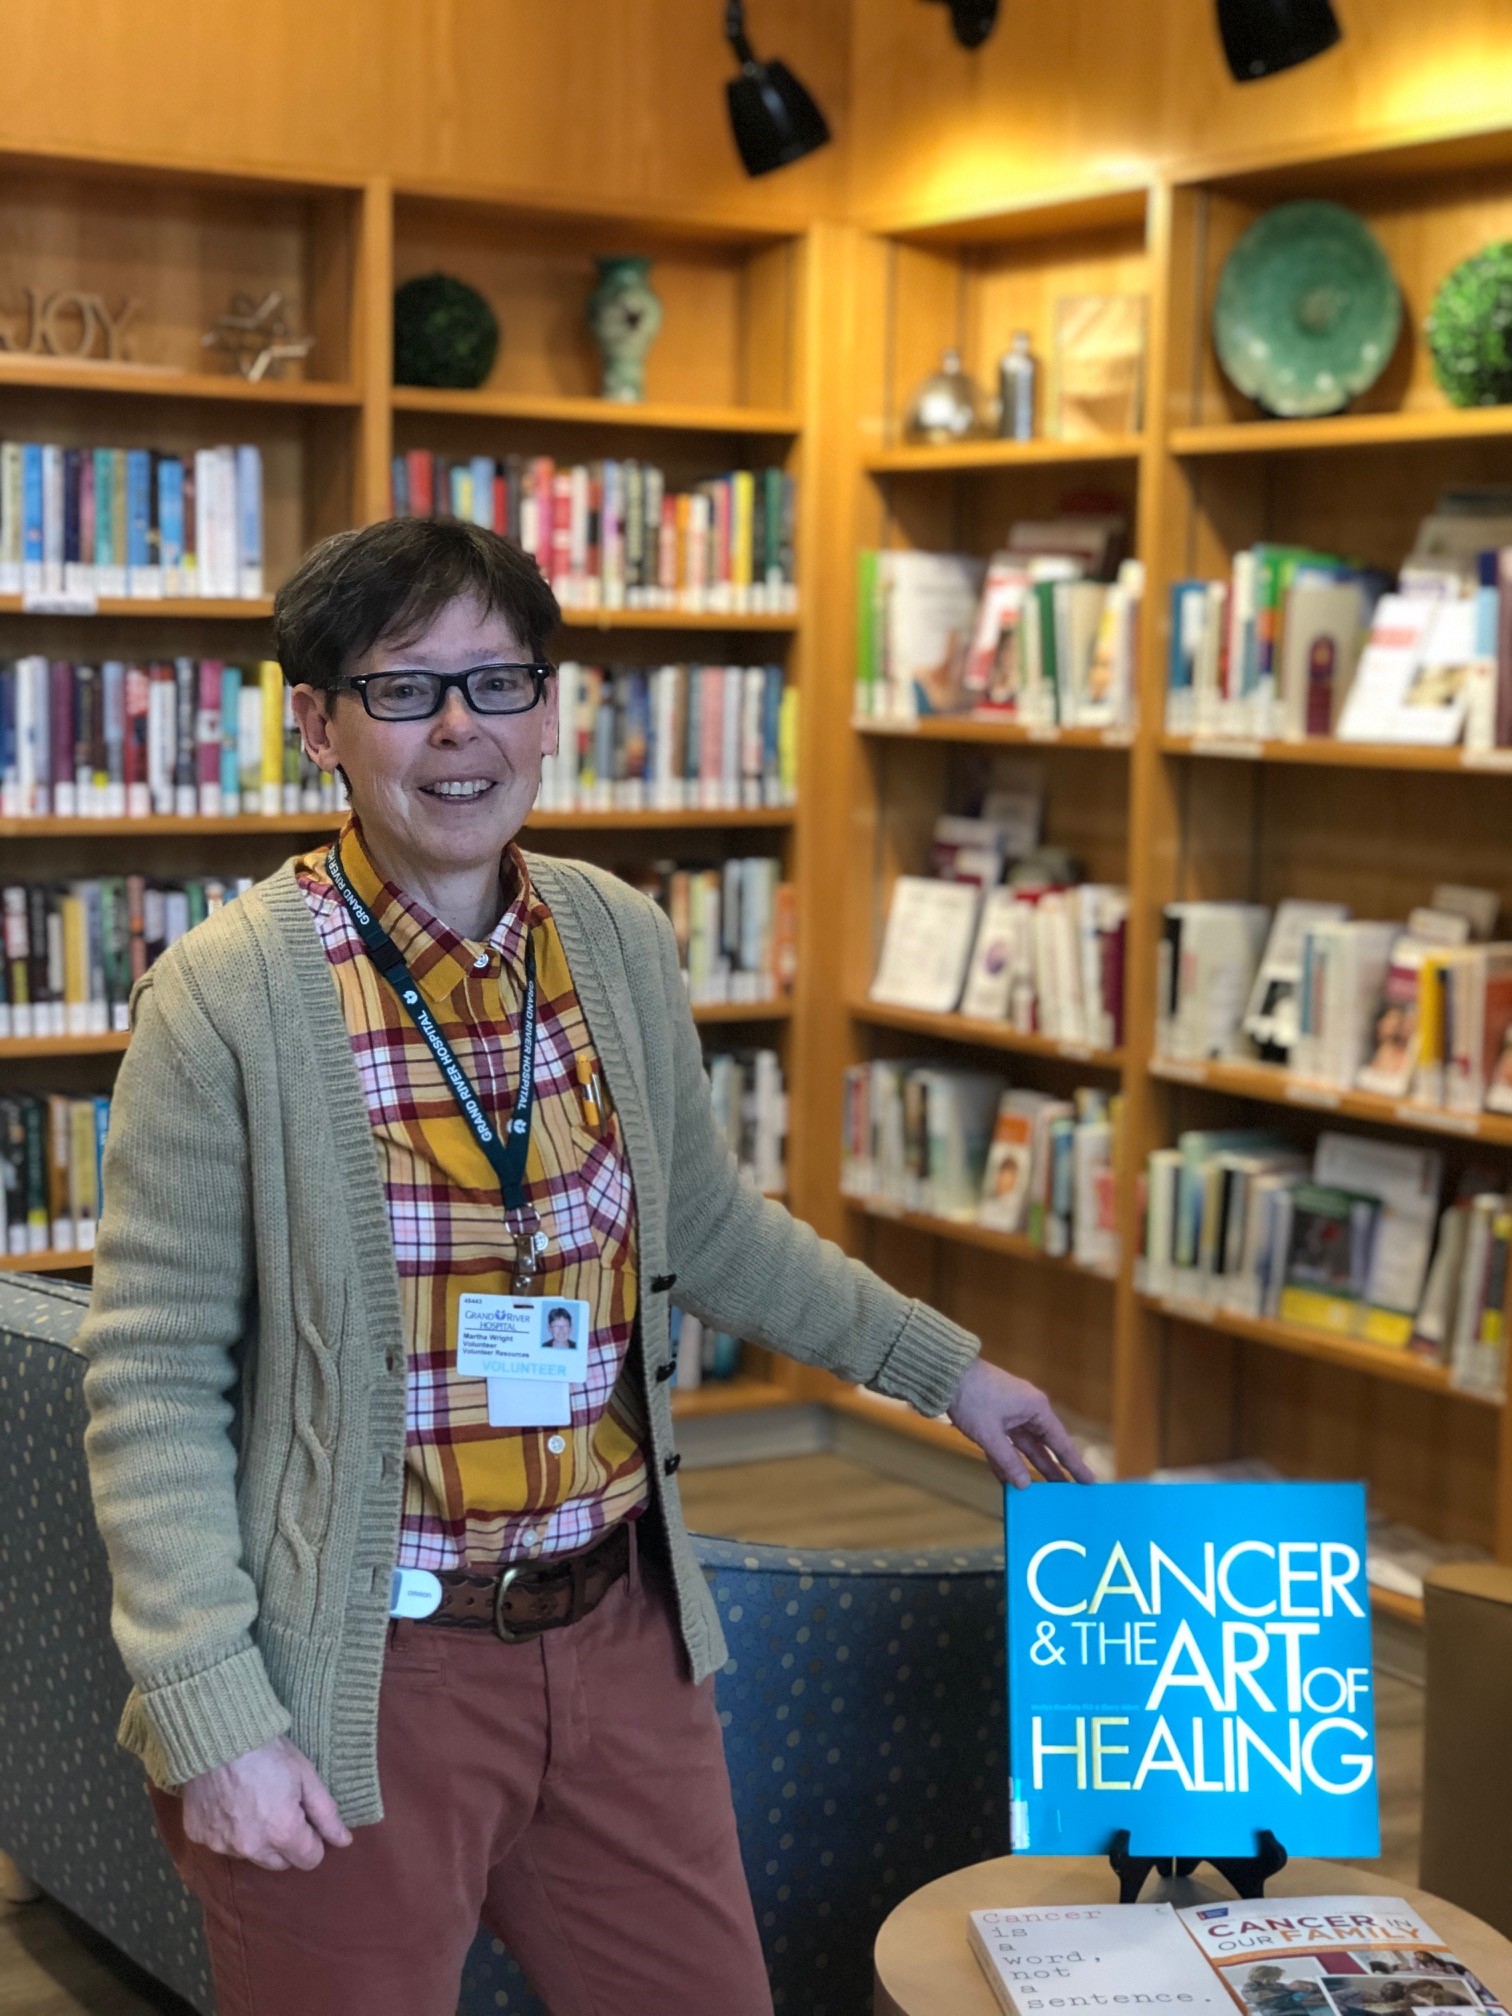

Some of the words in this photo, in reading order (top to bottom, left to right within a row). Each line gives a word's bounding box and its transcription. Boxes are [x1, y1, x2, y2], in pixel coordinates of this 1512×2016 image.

[0, 287, 141, 361] JOY
[328, 861, 346, 890] RIVER
[342, 888, 370, 925] GRAND
[526, 980, 535, 1019] GRAND
[417, 1010, 453, 1065] HOSPITAL
[523, 1020, 533, 1054] RIVER
[446, 1064, 472, 1101] RIVER
[517, 1055, 531, 1110] HOSPITAL
[465, 1100, 493, 1142] GRAND
[465, 1310, 494, 1321] GRAND
[506, 1313, 530, 1323] RIVER
[480, 1321, 518, 1331] HOSPITAL
[489, 1334, 514, 1343] Wright
[495, 1350, 530, 1358] Resources
[482, 1359, 567, 1377] VOLUNTEER
[1026, 1539, 1366, 1618] CANCER
[1030, 1620, 1066, 1666] &
[1071, 1620, 1157, 1666] THE
[1145, 1617, 1320, 1713] ART
[1302, 1666, 1369, 1713] OF
[1032, 1713, 1374, 1796] HEALING
[982, 1910, 1101, 1924] Cancer
[1207, 1914, 1377, 1938] CANCER
[1386, 1918, 1412, 1929] IN
[991, 1926, 1028, 1938] is
[1218, 1935, 1275, 1951] OUR
[1277, 1927, 1423, 1944] FAMILY
[998, 1942, 1016, 1952] a
[1002, 1950, 1101, 1966] word,
[1009, 1967, 1071, 1980] not
[1020, 1984, 1038, 1994] a
[1027, 1992, 1212, 2009] sentence.
